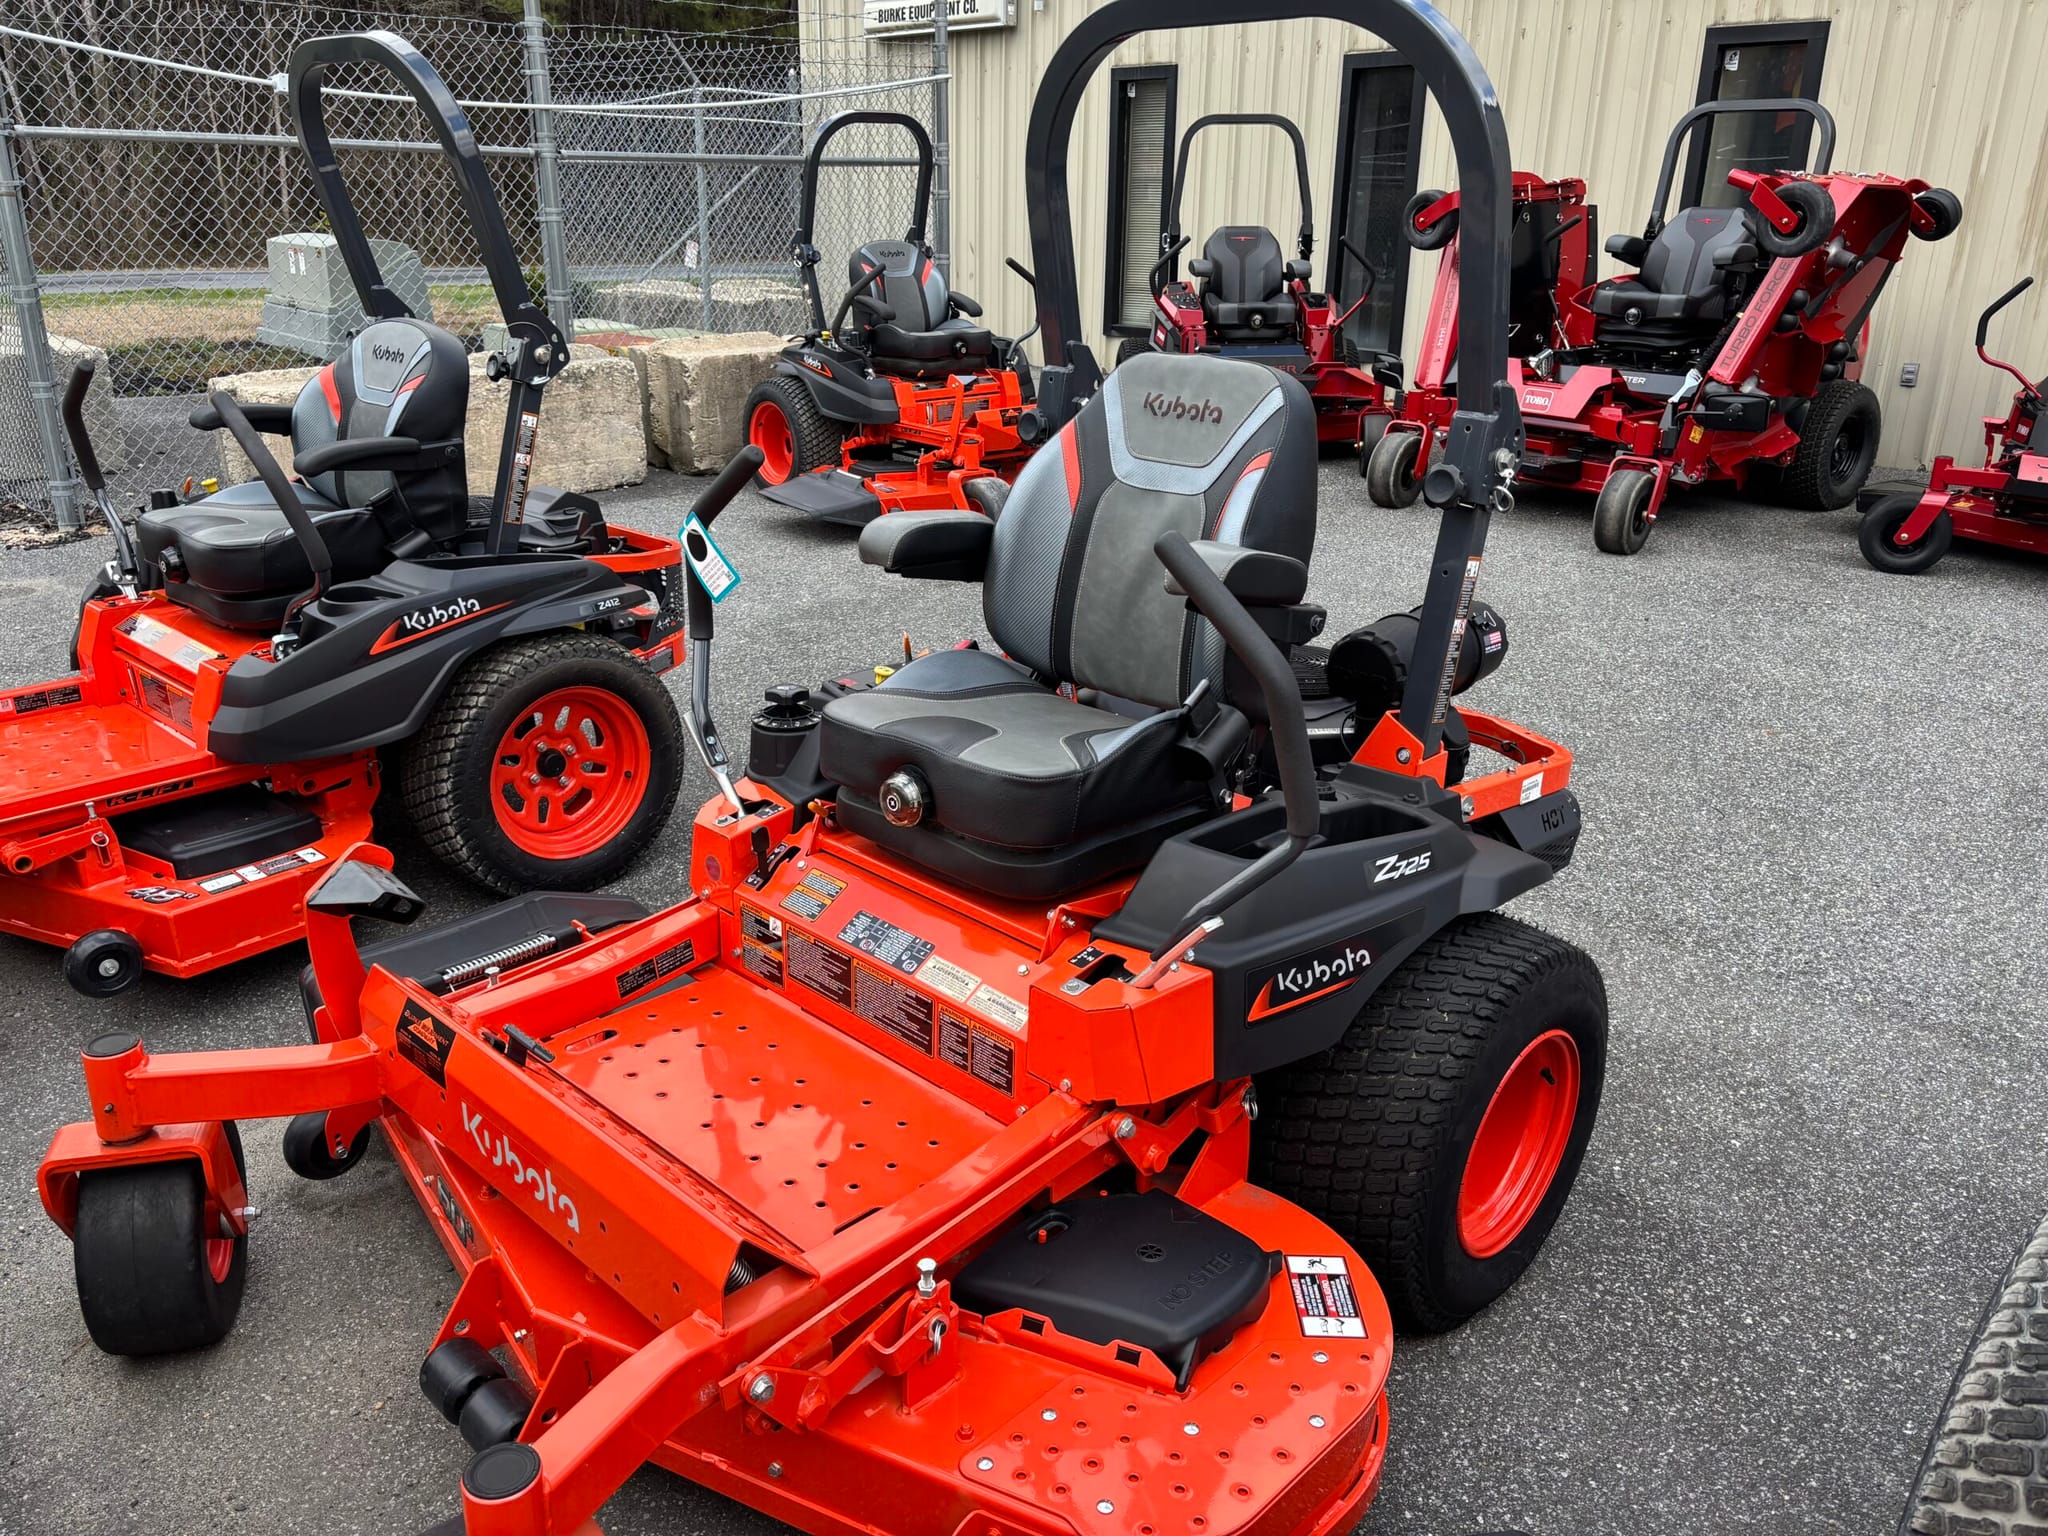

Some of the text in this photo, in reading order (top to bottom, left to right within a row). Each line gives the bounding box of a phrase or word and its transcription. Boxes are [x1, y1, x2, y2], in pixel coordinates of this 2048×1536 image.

[878, 0, 979, 23] BURKE EQUIPNT CO.
[879, 249, 905, 258] Kubota
[1719, 261, 1791, 369] TURBO FORCE
[372, 344, 405, 363] Kubota
[1143, 391, 1223, 424] Kubota
[1525, 394, 1549, 407] TORO
[403, 597, 480, 630] Kubota
[597, 598, 621, 610] Z412
[110, 780, 192, 807] K-LIFT
[1541, 806, 1565, 832] HOT
[1374, 851, 1432, 883] Z725
[1277, 948, 1371, 992] Kubota
[462, 1101, 579, 1234] Kubota
[1155, 1250, 1232, 1312] NO STEP
